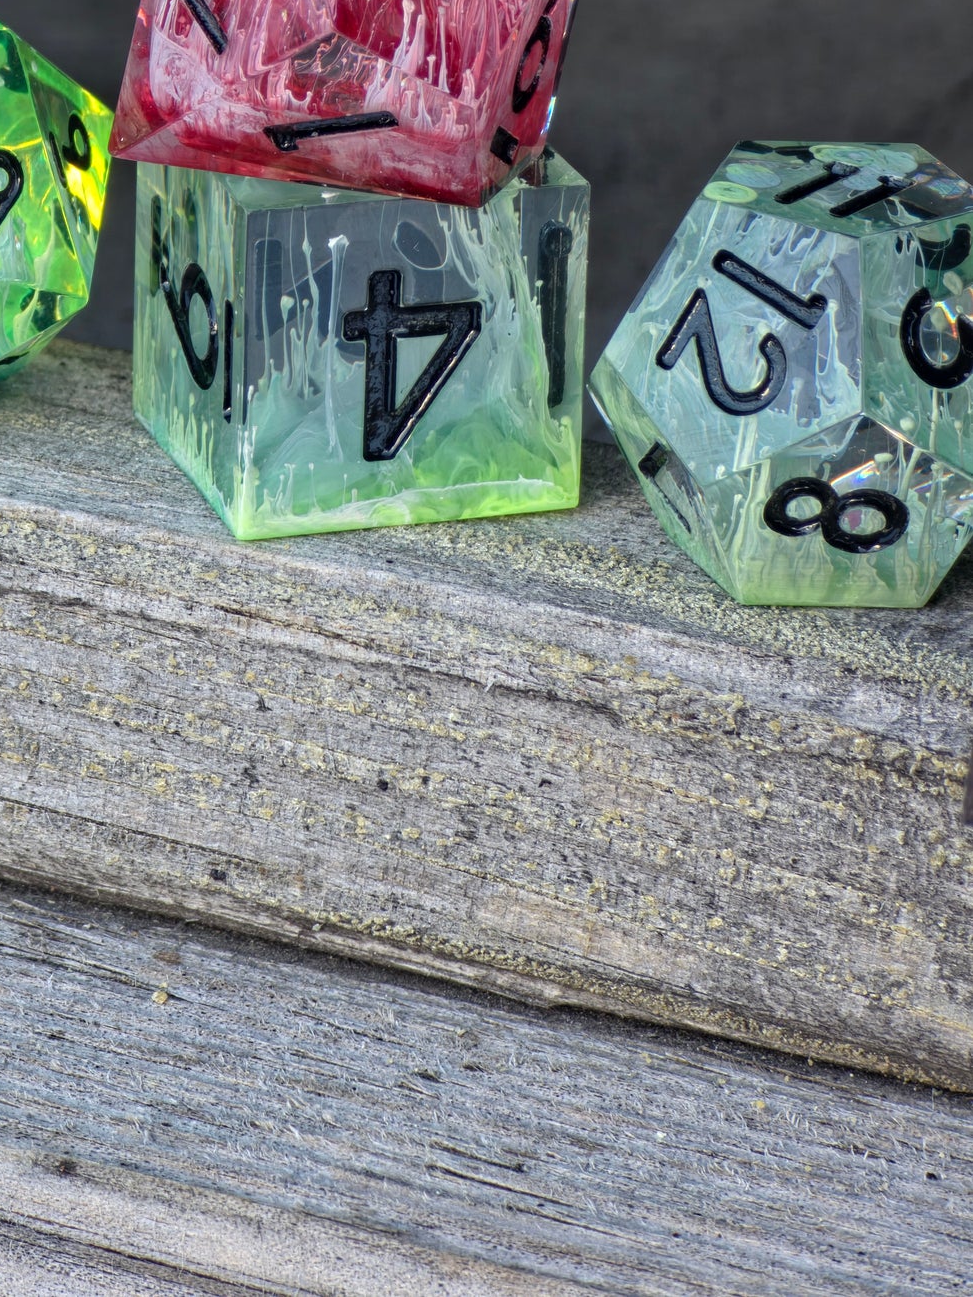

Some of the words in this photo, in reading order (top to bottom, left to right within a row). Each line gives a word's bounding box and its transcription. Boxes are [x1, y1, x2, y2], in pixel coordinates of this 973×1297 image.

[341, 269, 483, 462] 4
[655, 248, 828, 417] 12
[763, 476, 910, 554] 8
